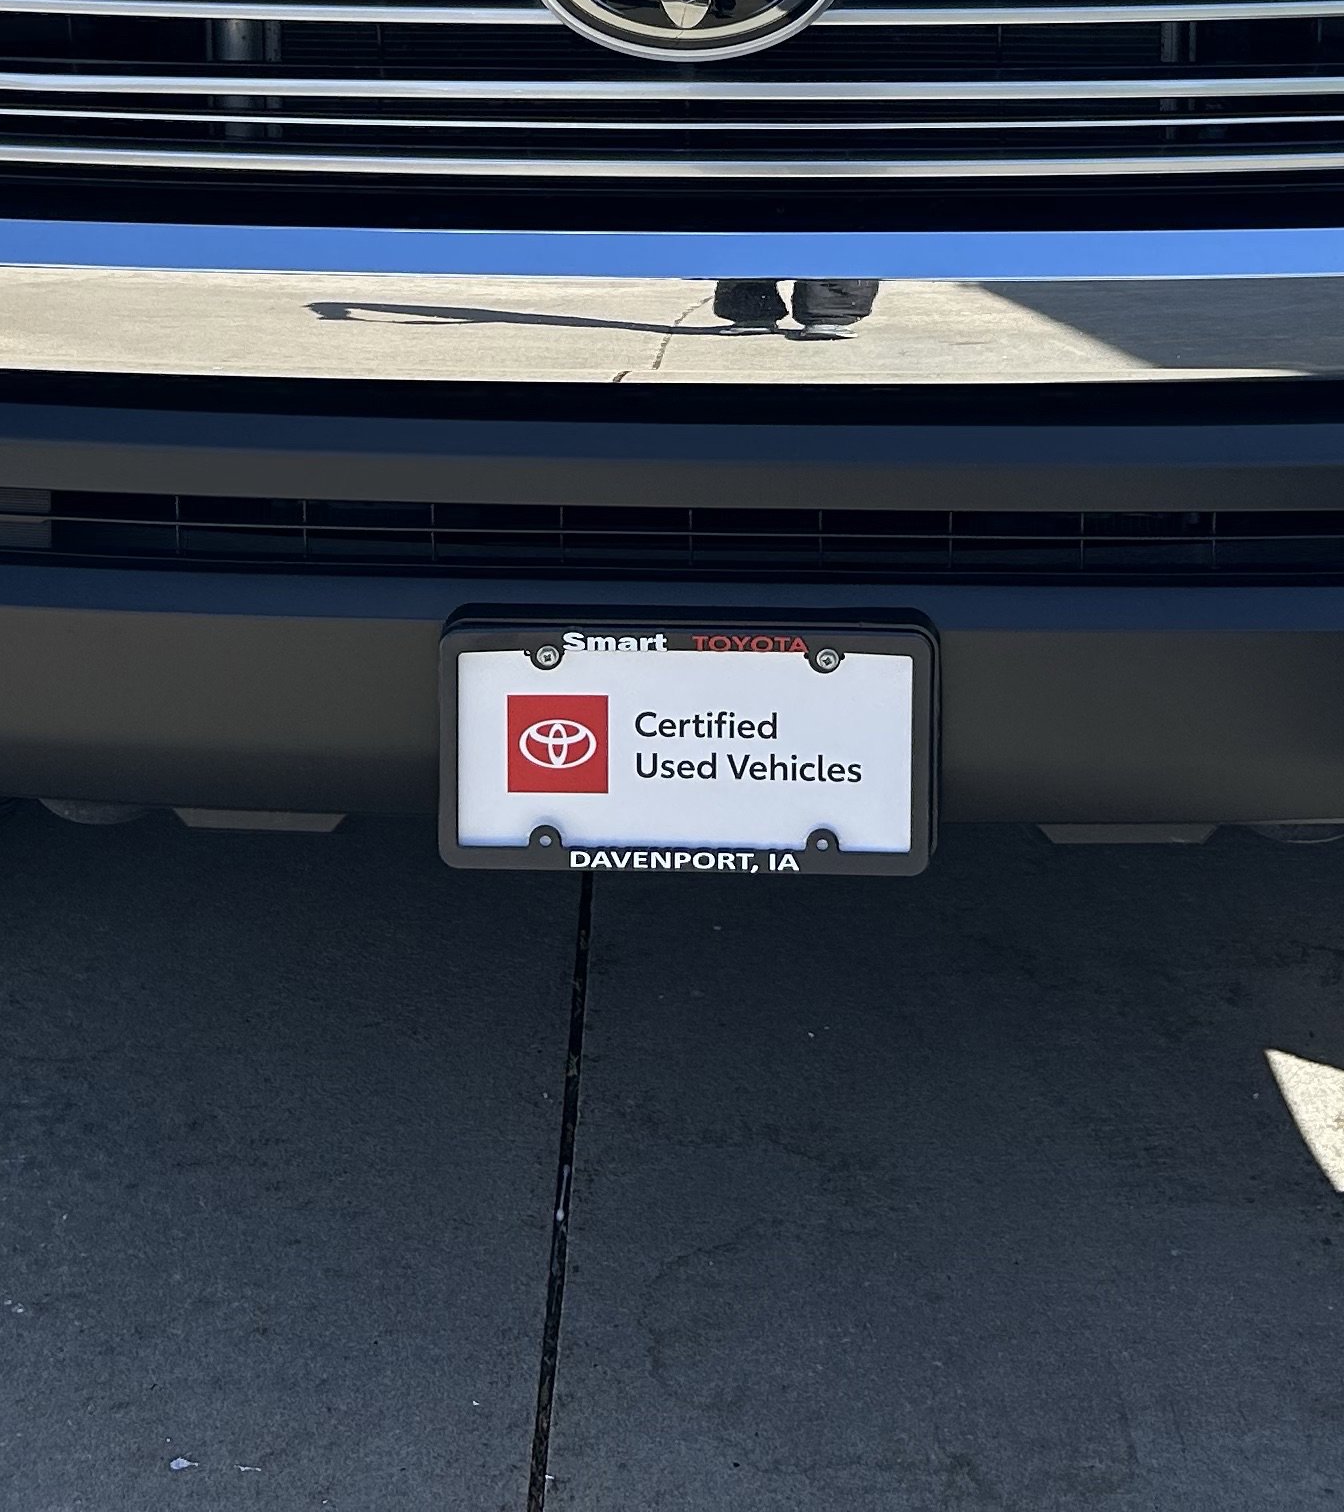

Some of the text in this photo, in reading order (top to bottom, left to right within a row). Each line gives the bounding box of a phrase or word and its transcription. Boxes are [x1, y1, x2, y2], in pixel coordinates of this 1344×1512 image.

[563, 632, 809, 653] Smart TOYOTA
[634, 711, 779, 740] Certified
[635, 752, 863, 783] Used Vehicles
[570, 851, 800, 874] DAVENPORT, IA
